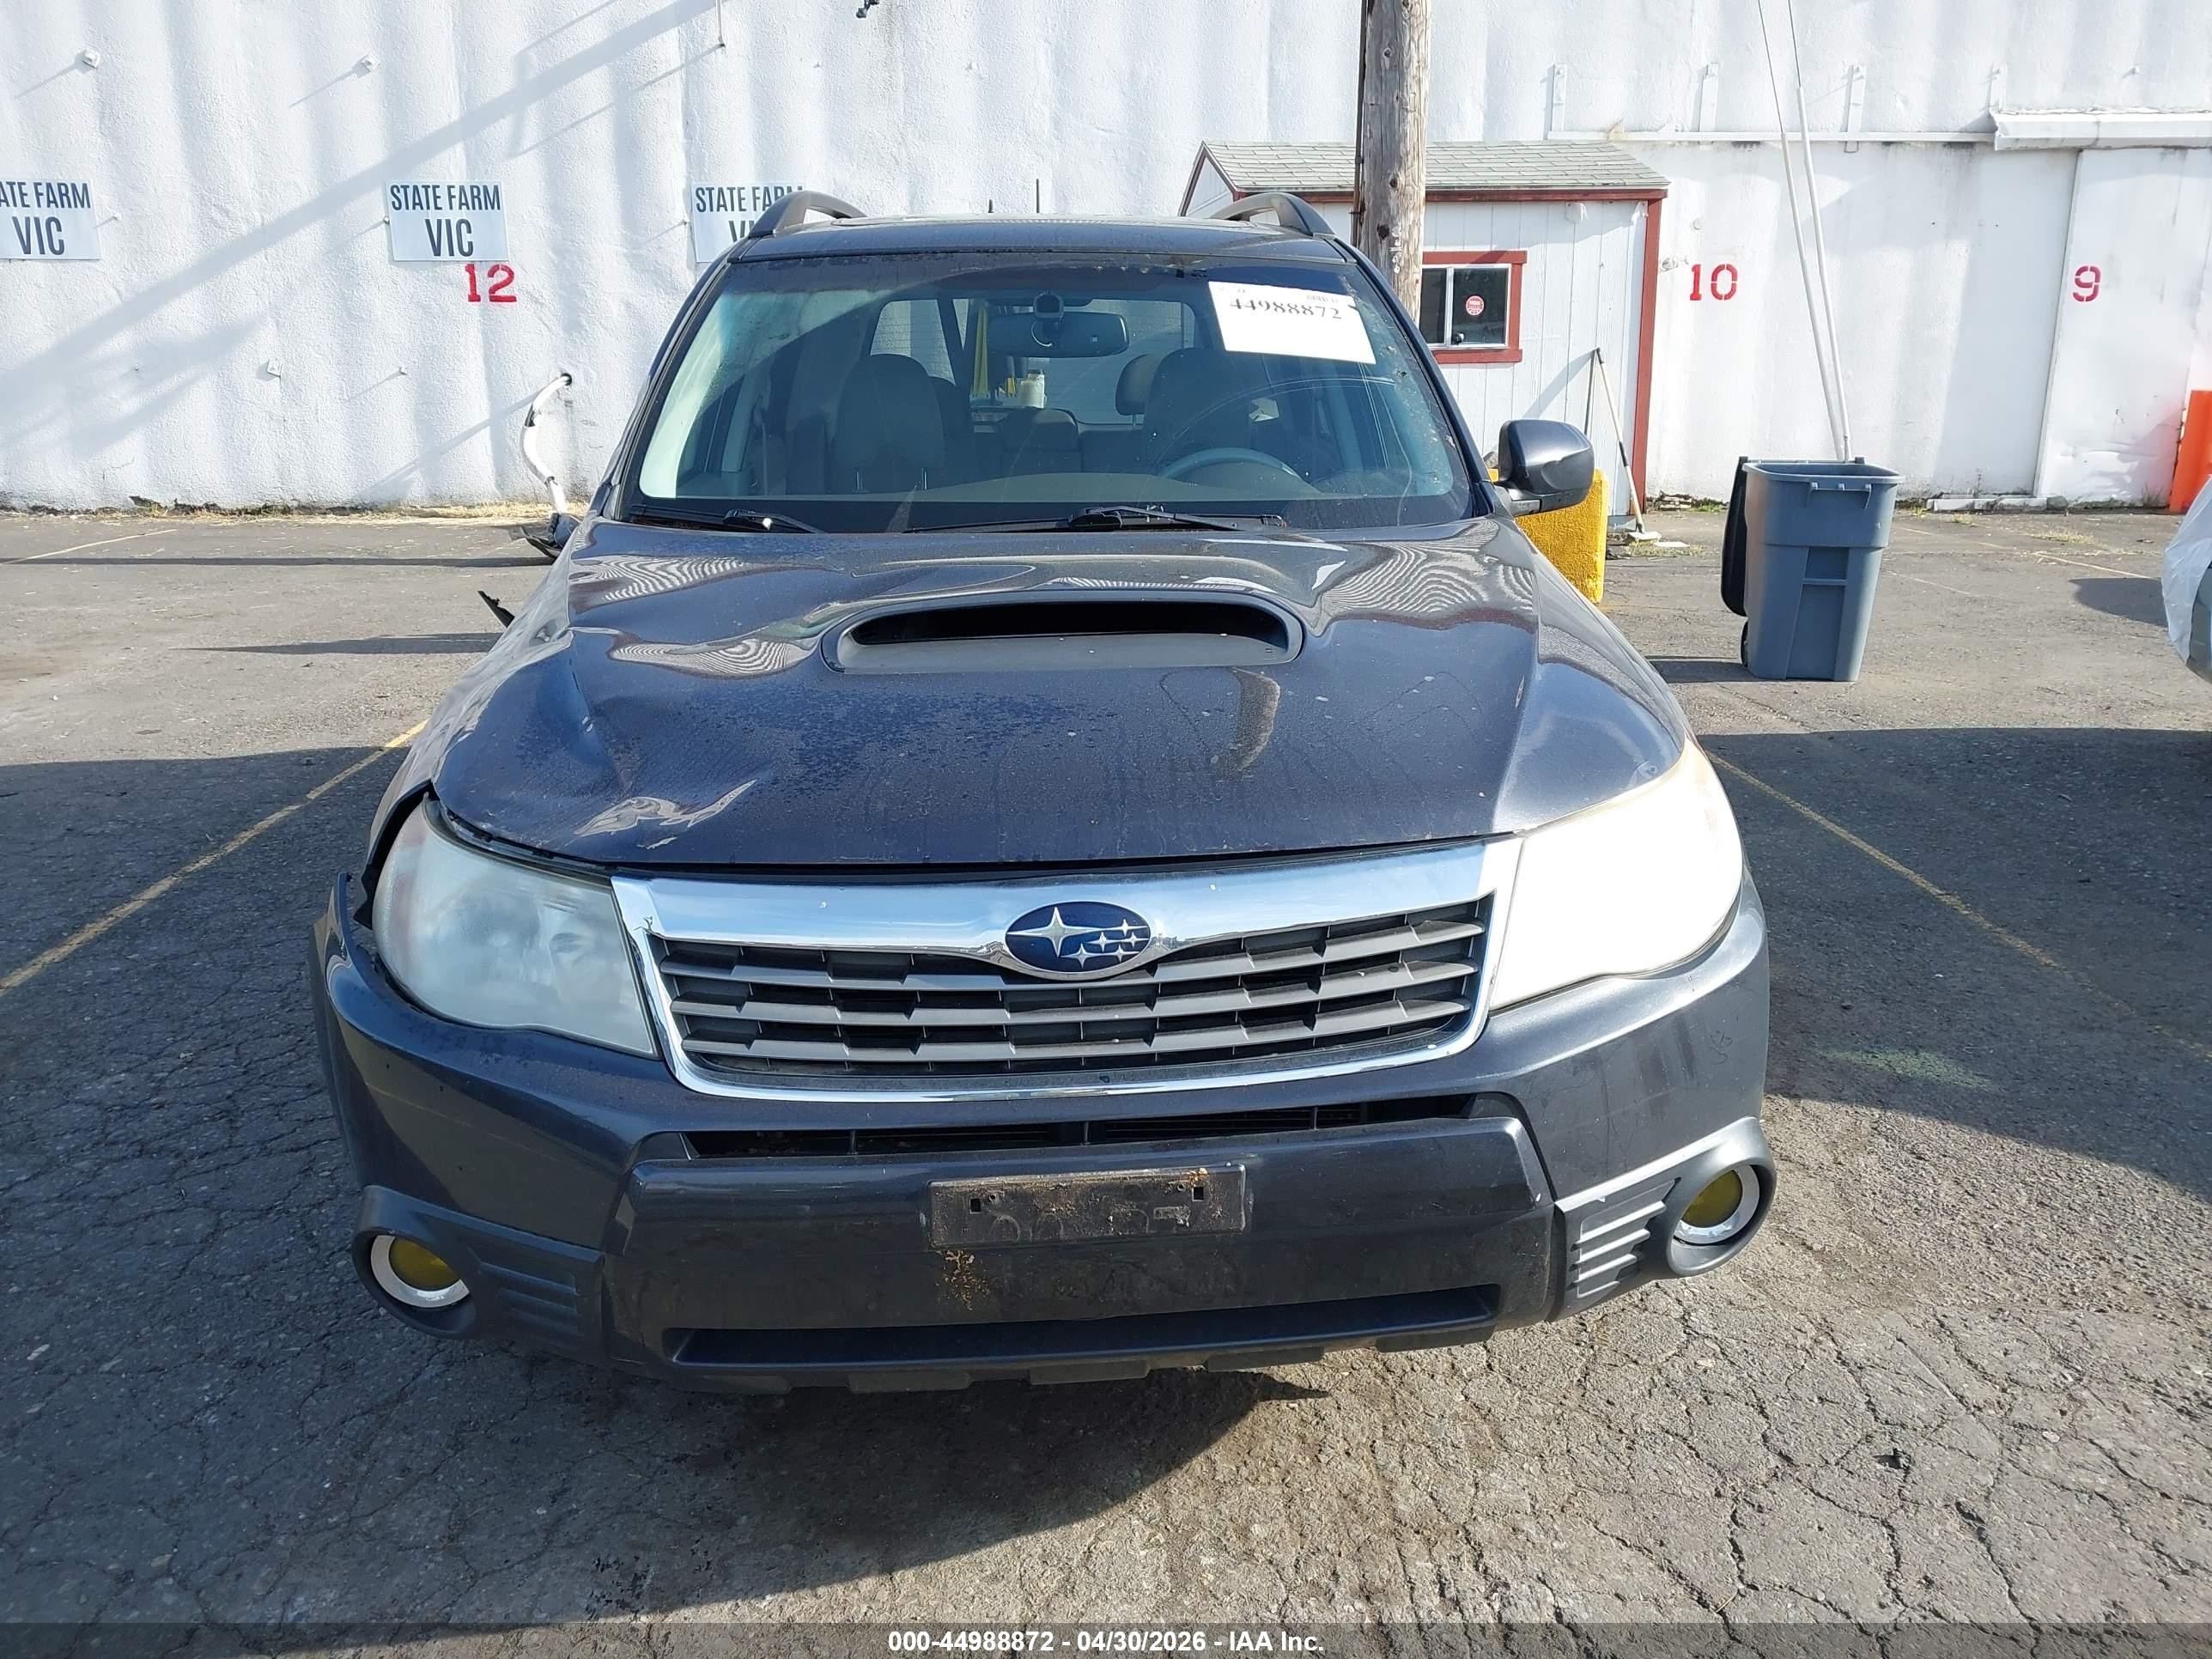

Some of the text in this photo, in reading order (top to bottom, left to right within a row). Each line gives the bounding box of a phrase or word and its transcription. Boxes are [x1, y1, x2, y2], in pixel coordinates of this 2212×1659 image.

[0, 180, 91, 209] ATE FARM
[390, 184, 501, 211] STATE FARM
[695, 185, 803, 213] STATE FA
[11, 216, 65, 256] VIC
[424, 218, 474, 258] VIC
[465, 263, 518, 303] 12
[1689, 263, 1738, 301] 10
[2072, 265, 2101, 302] 9
[1230, 298, 1343, 319] 44988872
